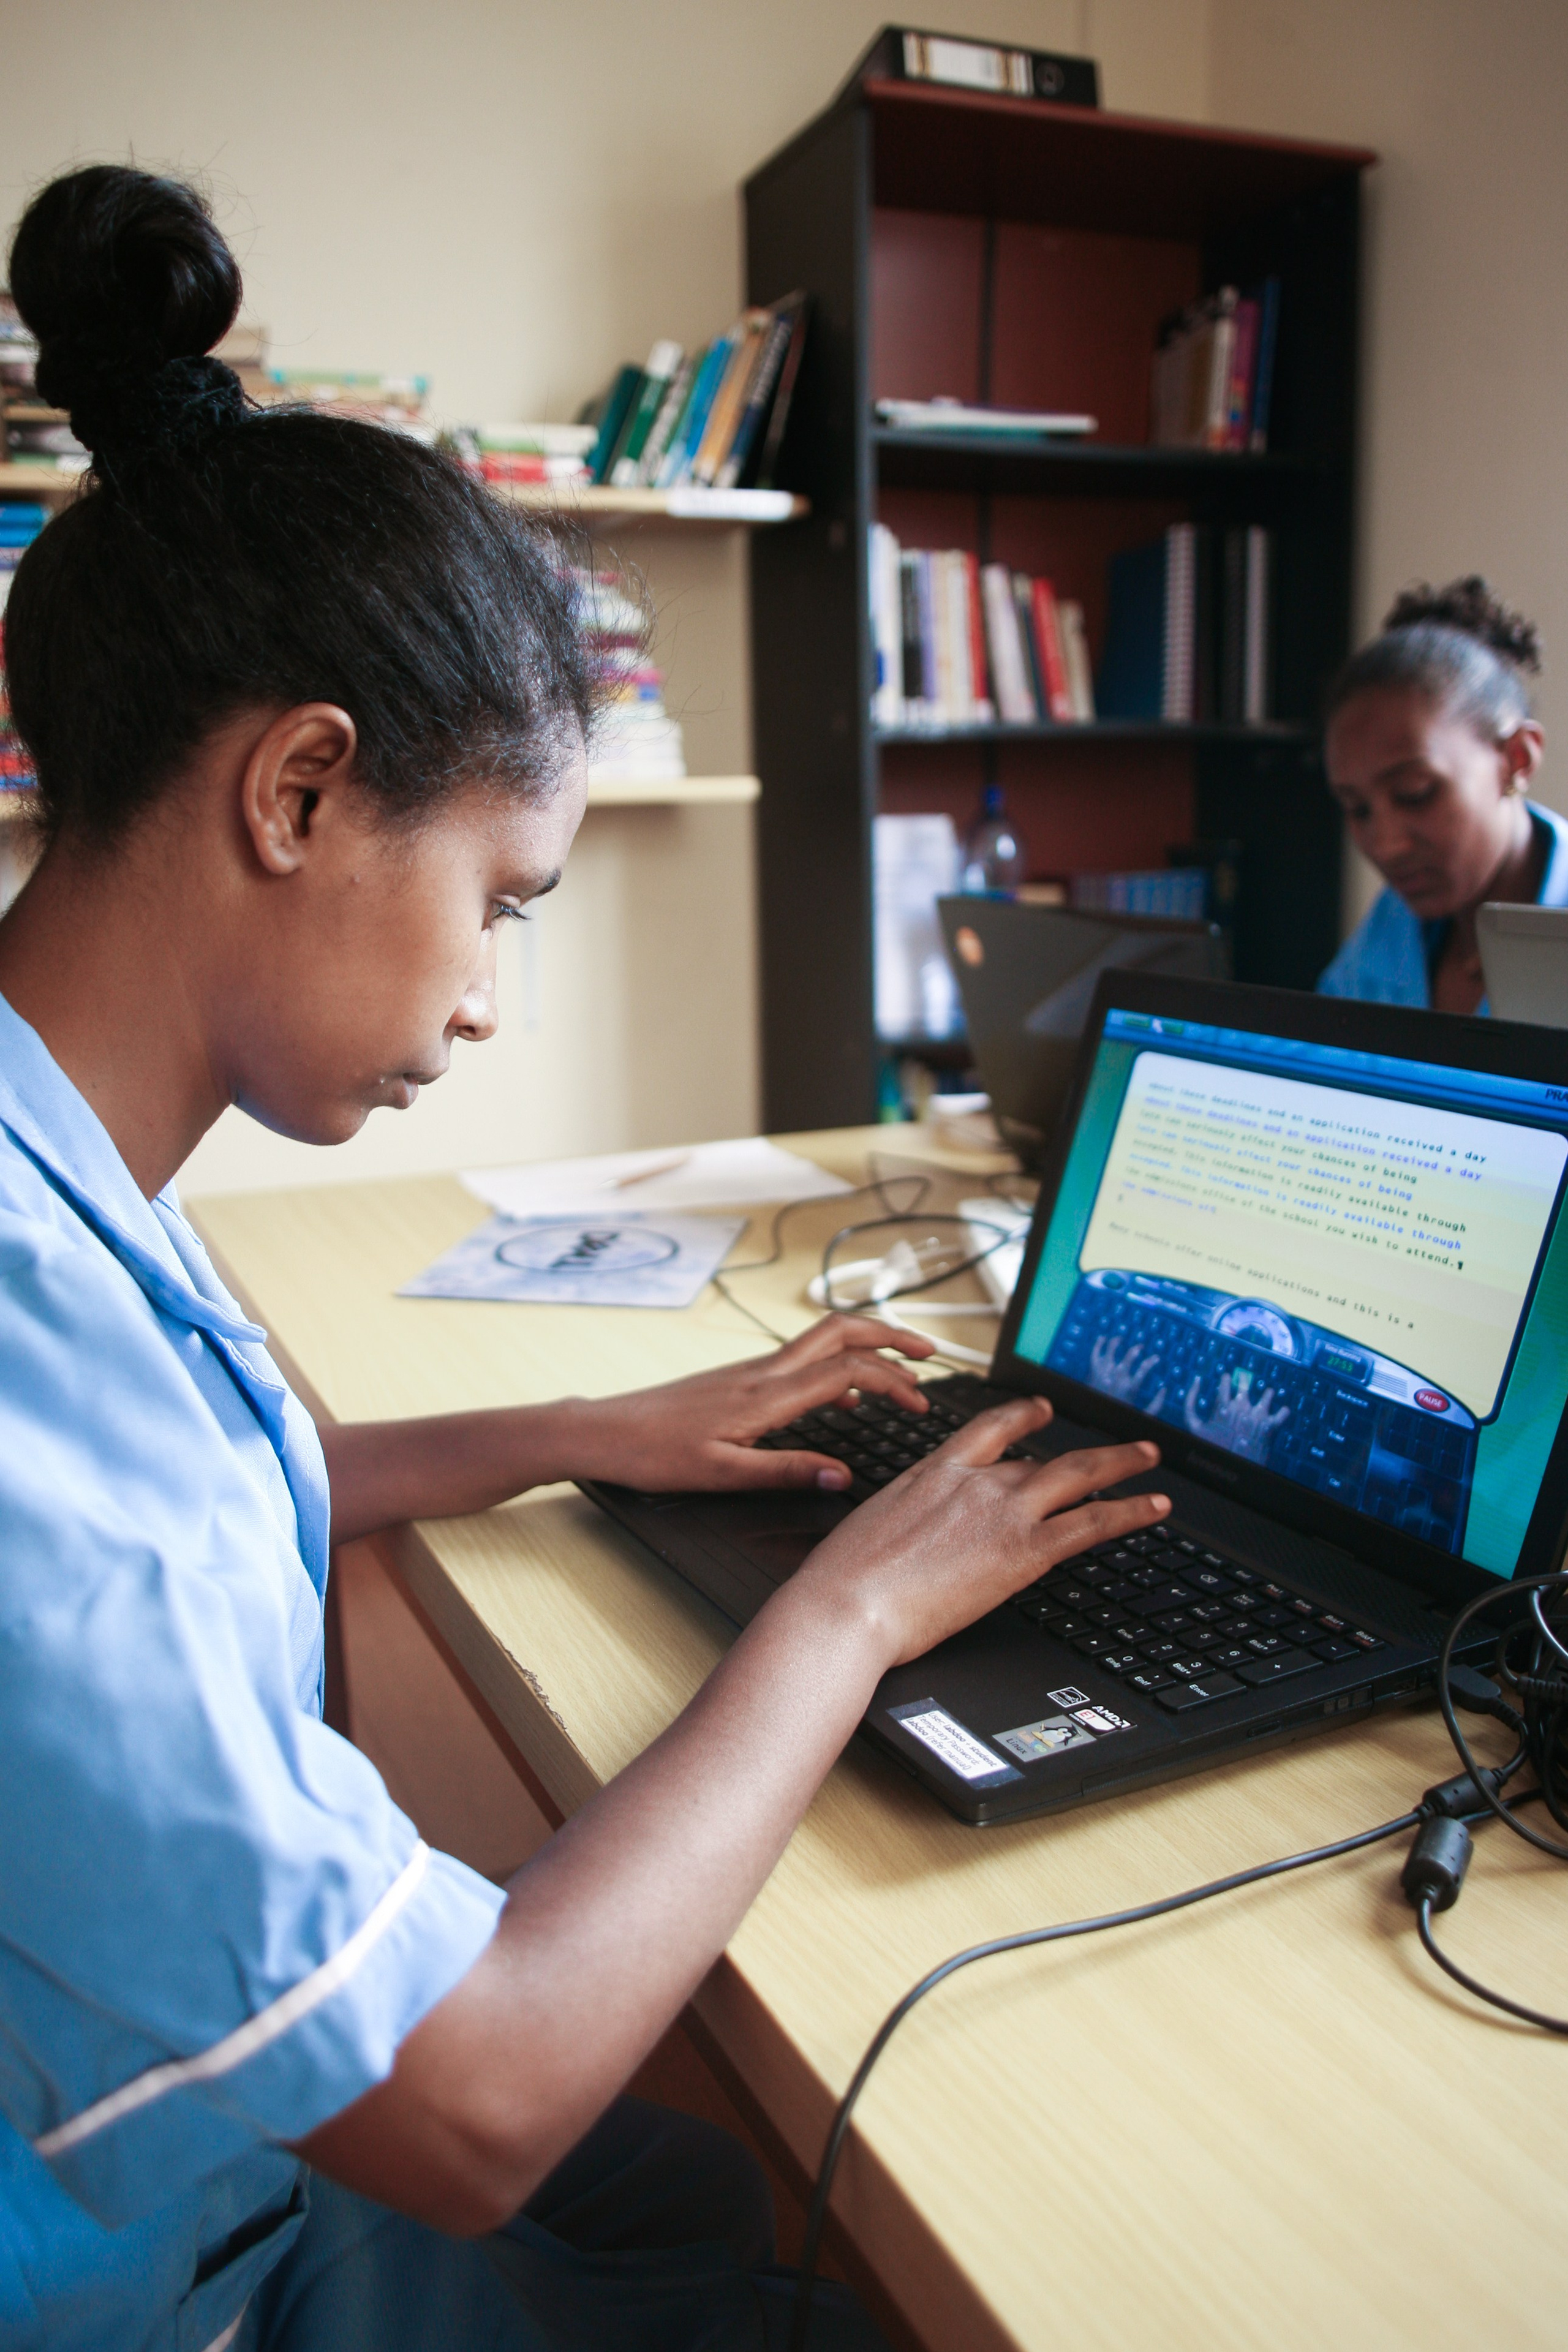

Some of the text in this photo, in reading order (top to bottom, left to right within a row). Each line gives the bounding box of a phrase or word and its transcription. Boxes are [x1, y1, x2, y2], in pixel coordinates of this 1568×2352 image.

[1263, 1125, 1281, 1133] and
[1305, 1134, 1376, 1155] application
[1382, 1152, 1438, 1169] received
[1459, 1167, 1482, 1181] day
[1310, 1118, 1381, 1138] application
[1387, 1135, 1443, 1152] received
[1464, 1150, 1487, 1163] day
[1278, 1160, 1302, 1170] your
[1308, 1168, 1353, 1184] chances
[1379, 1184, 1414, 1200] being
[1282, 1145, 1306, 1155] your
[1313, 1152, 1358, 1167] chances
[1384, 1168, 1419, 1183] being
[1275, 1191, 1287, 1201] is
[1293, 1198, 1337, 1216] readily
[1343, 1212, 1404, 1234] available
[1411, 1229, 1462, 1249] through
[1280, 1176, 1292, 1185] is
[1297, 1182, 1342, 1199] readily
[1348, 1196, 1409, 1216] available
[1416, 1212, 1467, 1232] through
[1259, 1204, 1276, 1215] the
[1283, 1212, 1320, 1227] school
[1325, 1224, 1346, 1234] you
[1352, 1232, 1379, 1244] wish
[1385, 1240, 1400, 1250] to
[1247, 1267, 1321, 1297] applications
[1327, 1295, 1347, 1306] and
[1353, 1302, 1380, 1317] this
[1387, 1313, 1401, 1324] is
[1419, 1393, 1442, 1407] PAUSE
[1172, 1662, 1186, 1673] Bild
[1189, 1683, 1210, 1697] Enter
[1079, 1711, 1096, 1720] E1
[1092, 1706, 1121, 1722] AMD
[919, 1715, 980, 1766] Temporary Password:
[925, 1735, 945, 1750] (refer
[944, 1749, 973, 1771] manual)
[928, 1712, 945, 1725] User:
[969, 1746, 998, 1767] student
[1006, 1738, 1028, 1754] Linux
